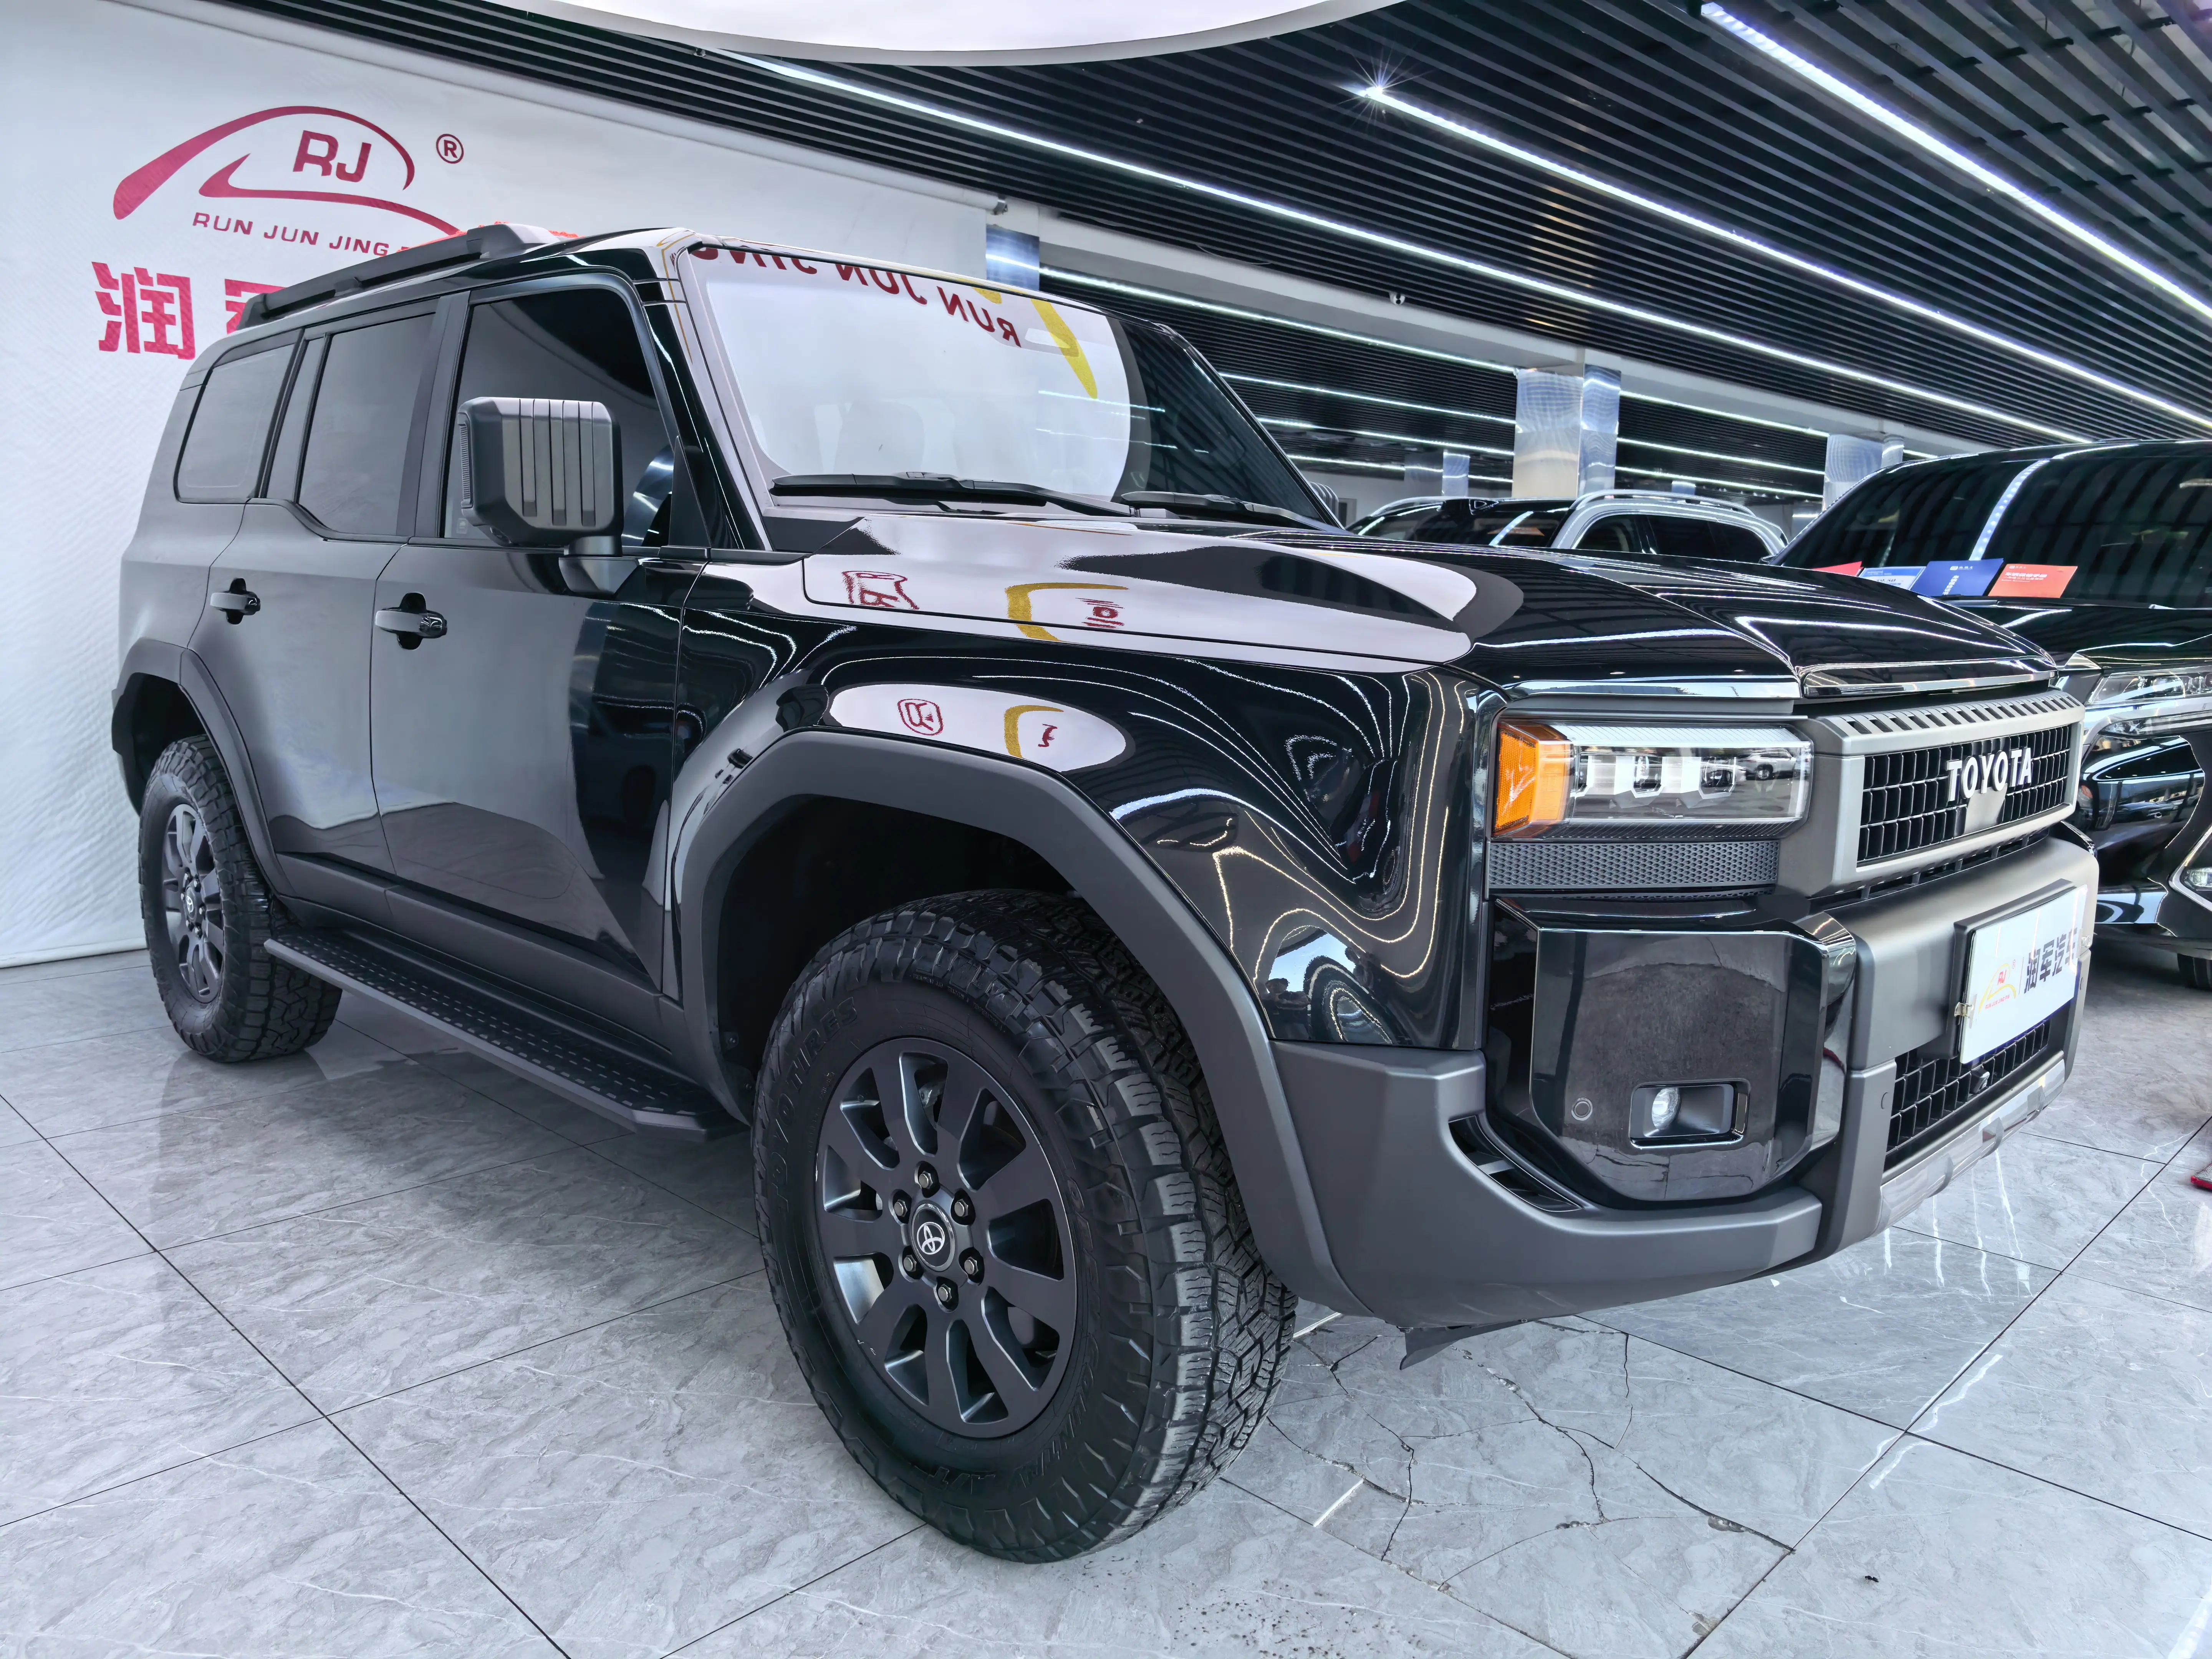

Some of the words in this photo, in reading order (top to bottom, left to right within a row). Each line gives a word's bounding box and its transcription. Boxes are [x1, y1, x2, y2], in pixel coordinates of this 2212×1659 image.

[293, 130, 372, 182] RJ
[192, 212, 253, 235] RUN
[263, 225, 319, 245] JUN
[329, 236, 389, 257] JING
[1946, 747, 2032, 802] TOYOTA
[786, 997, 858, 1094] TIRES
